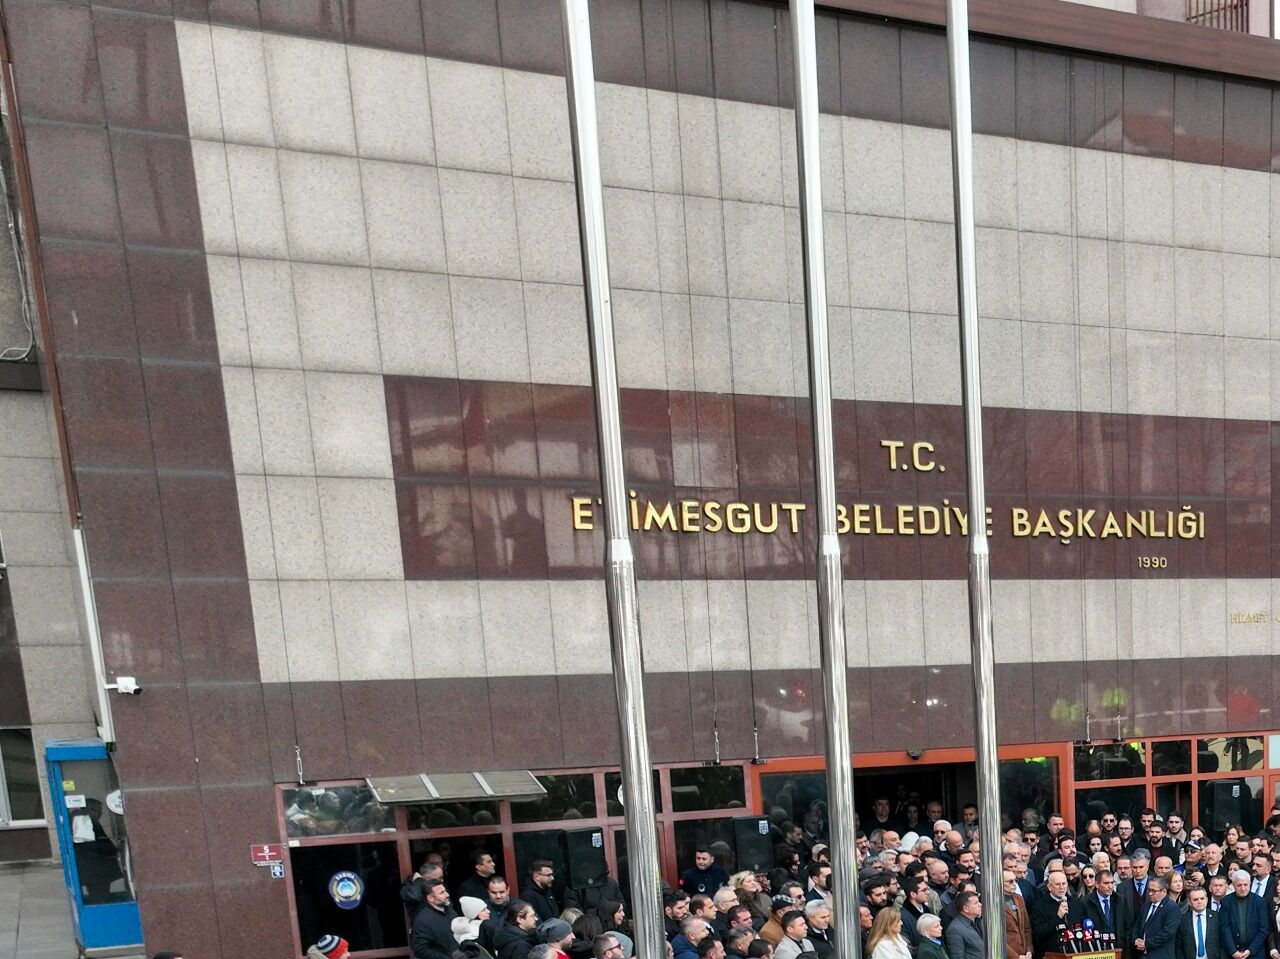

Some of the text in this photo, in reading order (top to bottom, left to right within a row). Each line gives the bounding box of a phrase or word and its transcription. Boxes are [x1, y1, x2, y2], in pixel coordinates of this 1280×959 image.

[880, 440, 946, 472] T.C.
[572, 489, 807, 534] EİMESGUT
[1011, 505, 1205, 545] BAŞKANLIĞI
[1138, 556, 1168, 569] 1990
